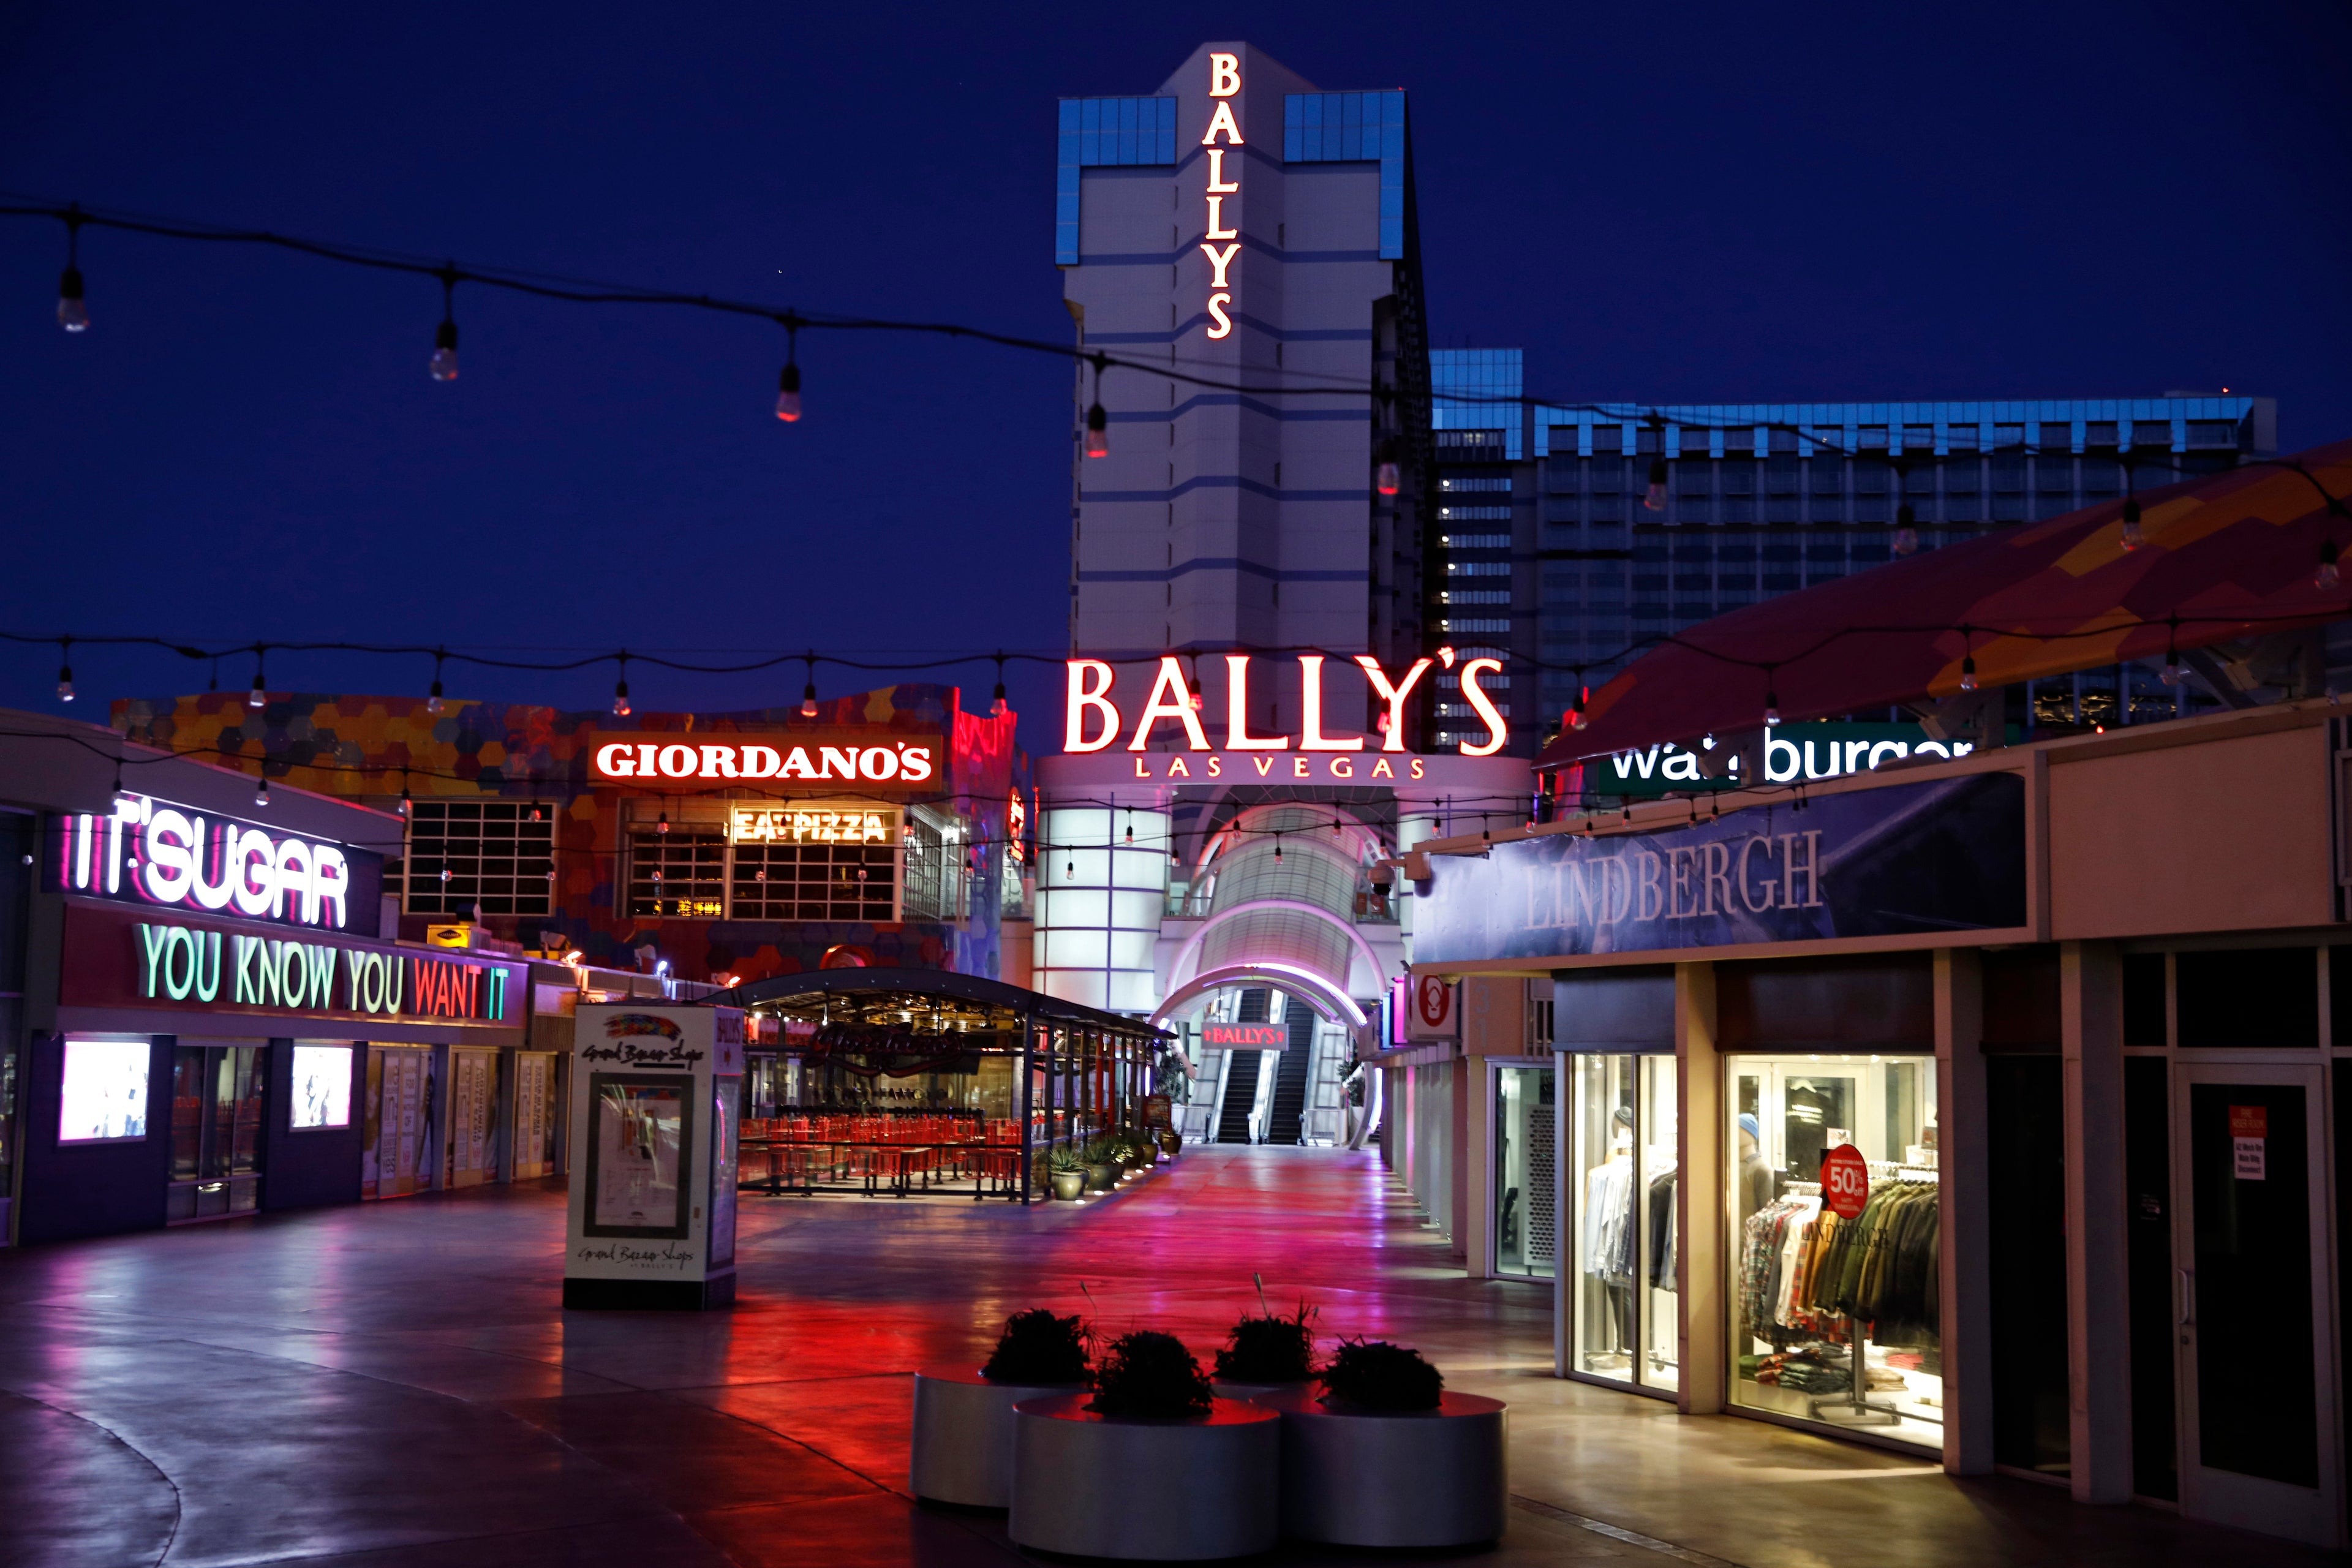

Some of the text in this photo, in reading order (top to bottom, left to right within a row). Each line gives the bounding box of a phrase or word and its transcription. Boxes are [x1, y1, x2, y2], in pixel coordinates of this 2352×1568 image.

[1063, 646, 1508, 756] BALLY'S
[596, 742, 932, 781] GIORDANO'S
[1134, 756, 1425, 780] LAS VEGAS
[736, 813, 886, 848] EAT PIZZA
[1523, 829, 1823, 931] LINDBERGH
[141, 923, 510, 1020] YOU KNOW YOU WANT IT
[582, 1042, 623, 1062] Grand
[1213, 1027, 1276, 1044] BALLY'S
[578, 1243, 617, 1262] Grand
[663, 1241, 694, 1270] Shops
